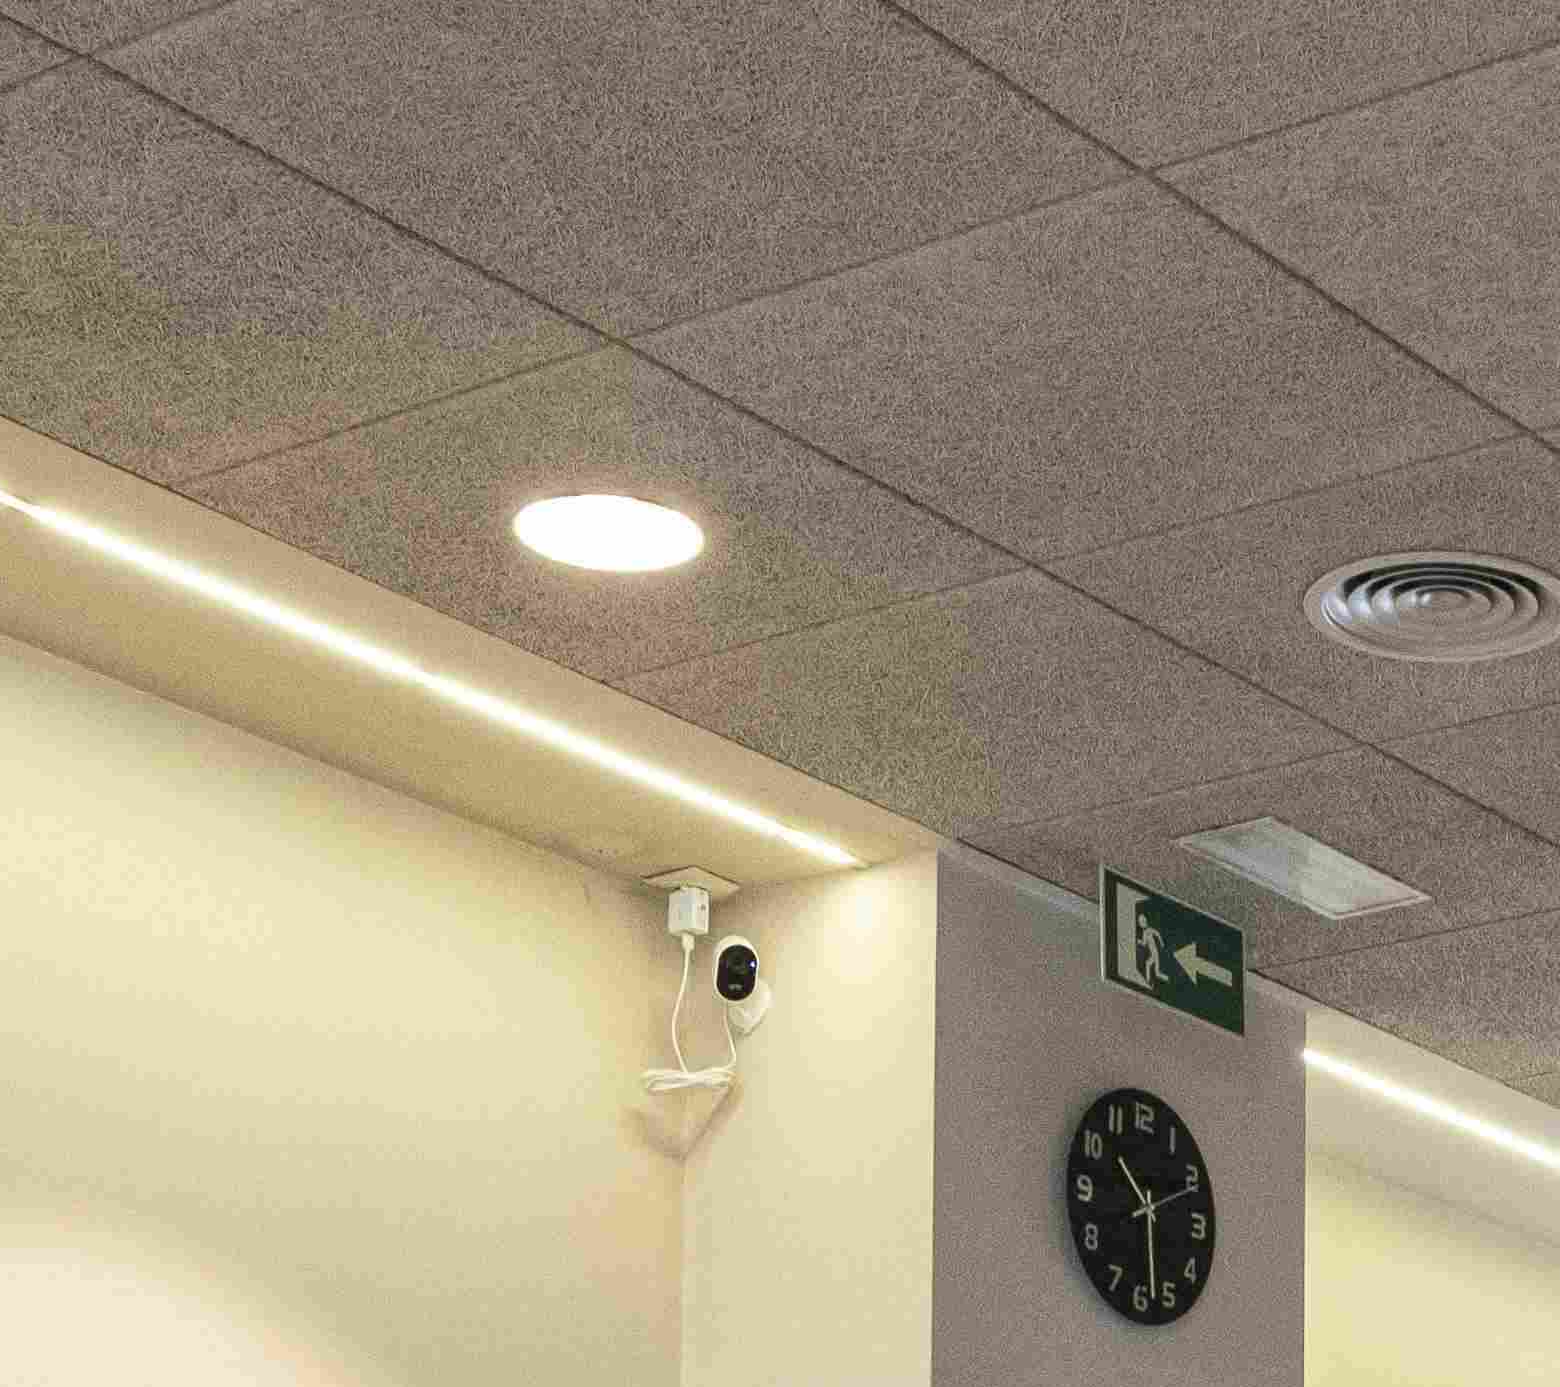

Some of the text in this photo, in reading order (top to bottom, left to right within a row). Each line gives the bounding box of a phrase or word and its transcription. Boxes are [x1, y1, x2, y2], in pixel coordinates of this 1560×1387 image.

[1108, 1104, 1123, 1134] 11
[1135, 1102, 1153, 1135] 12
[1084, 1129, 1103, 1159] 10
[1168, 1125, 1176, 1154] 1
[1076, 1174, 1093, 1202] 9
[1185, 1164, 1199, 1193] 2
[1084, 1223, 1098, 1250] 8
[1191, 1212, 1206, 1240] 3
[1107, 1264, 1123, 1291] 7
[1183, 1257, 1196, 1283] 4
[1132, 1284, 1148, 1312] 6
[1162, 1281, 1176, 1308] 5
